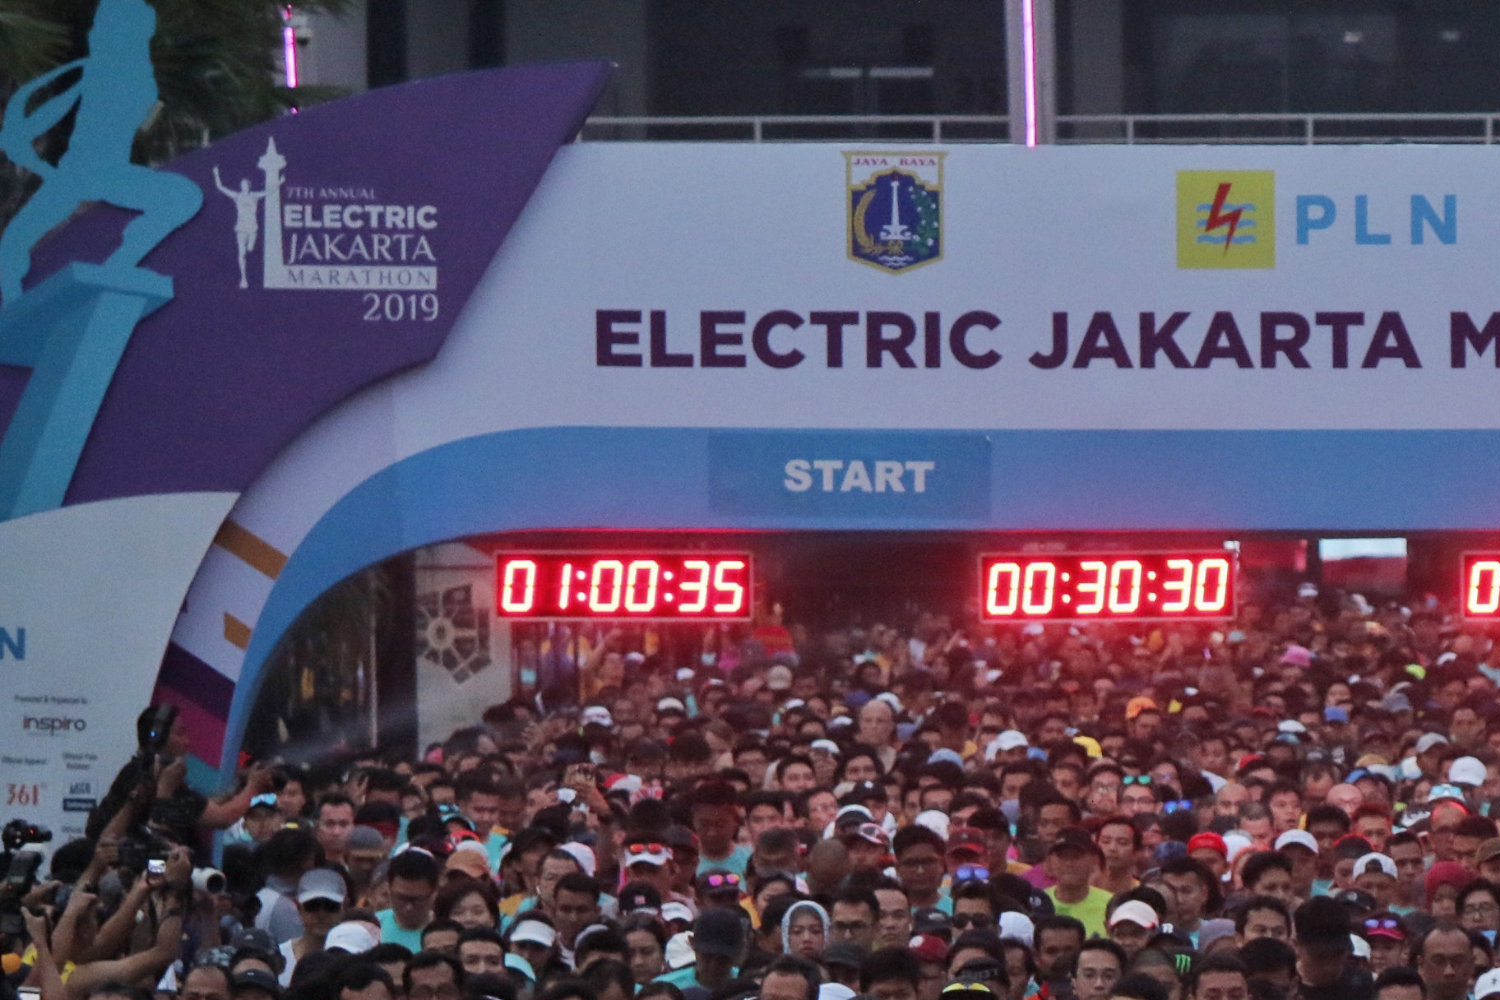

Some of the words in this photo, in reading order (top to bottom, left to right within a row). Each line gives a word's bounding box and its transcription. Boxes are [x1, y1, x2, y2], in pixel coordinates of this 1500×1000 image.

[853, 157, 889, 166] JAYA
[899, 157, 937, 166] RAYA
[286, 187, 315, 199] 7TH
[318, 187, 377, 199] ANNUAL
[283, 203, 439, 230] ELECTRIC
[1295, 193, 1458, 246] PLN
[288, 233, 437, 265] JAKARTA
[286, 268, 432, 286] MARATHON
[362, 292, 440, 322] 2019
[595, 309, 1004, 370] ELECTRIC
[1027, 309, 1423, 370] JAKARTA
[783, 458, 936, 494] START
[501, 559, 746, 613] 01:00:35
[986, 558, 1230, 615] 00:30:30
[23, 714, 87, 735] inspiro
